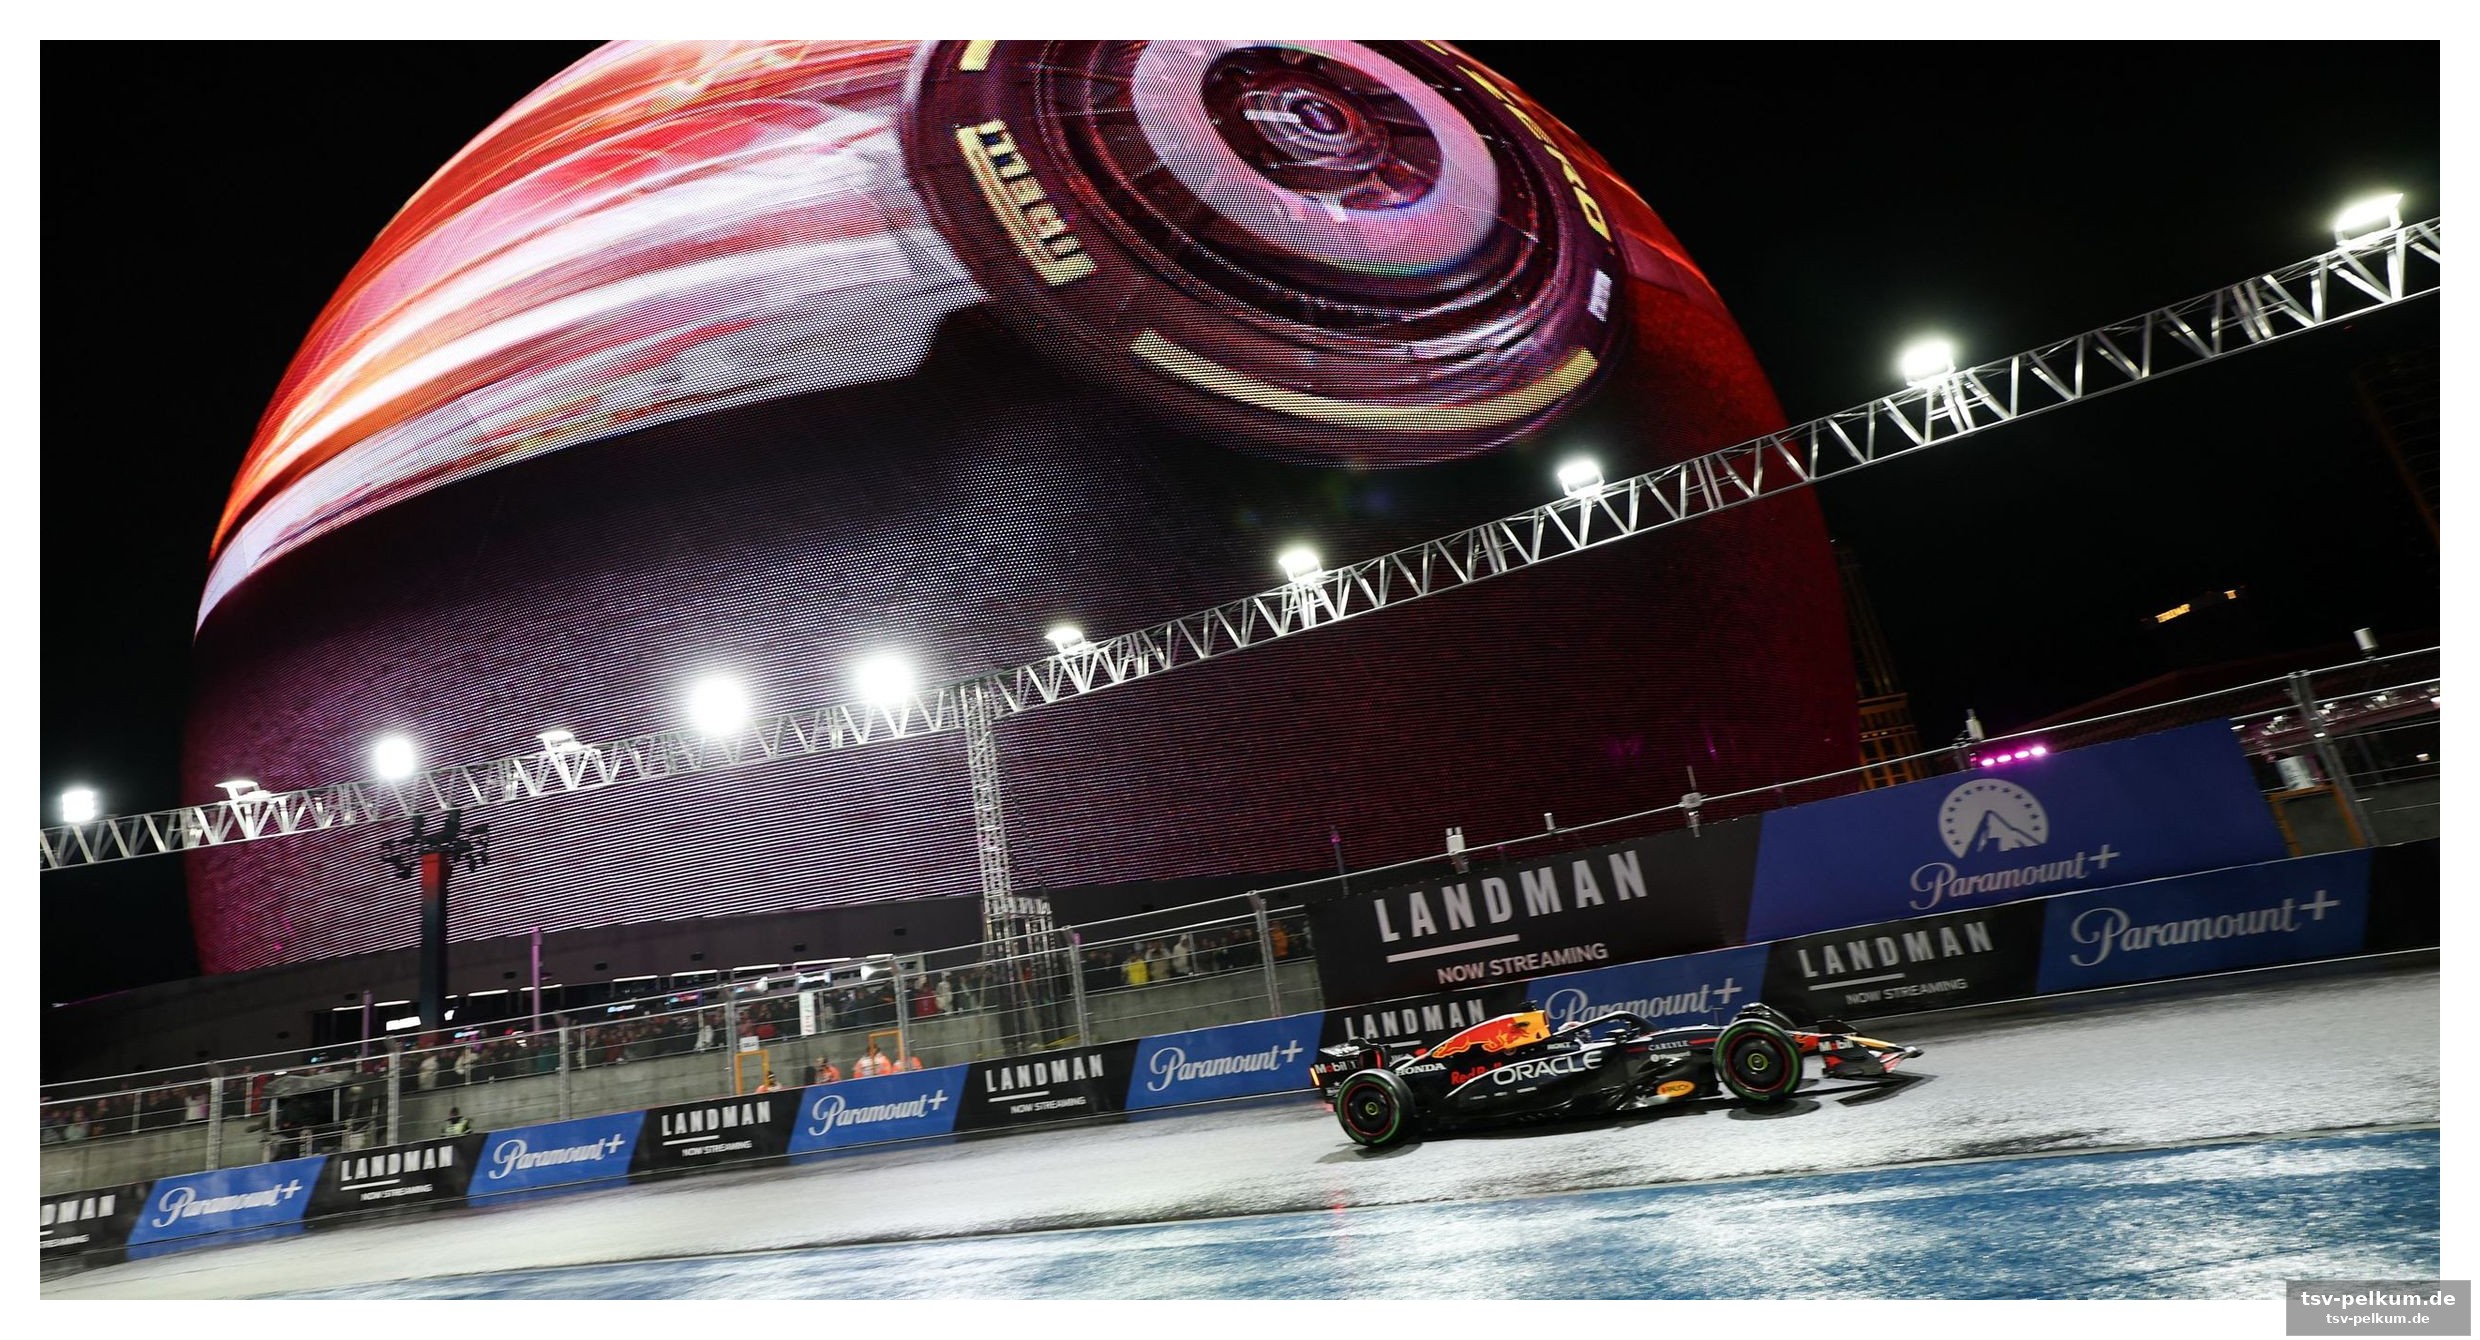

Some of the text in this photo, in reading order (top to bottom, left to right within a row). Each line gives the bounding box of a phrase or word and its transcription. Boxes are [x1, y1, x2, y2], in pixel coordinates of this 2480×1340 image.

[1374, 850, 1648, 943] LANDMAN
[1436, 942, 1609, 985] NOW STREAMING
[1799, 921, 1994, 978] LANDMAN
[1846, 978, 1968, 1005] NOW STREAMING
[1344, 998, 1485, 1040] LANDMAN
[985, 1054, 1104, 1092] LANDMAN
[1314, 1061, 1348, 1074] Mobil
[1395, 1063, 1447, 1077] HONDA
[1493, 1050, 1603, 1086] ORACLE
[661, 1101, 771, 1136] LANDMAN
[340, 1145, 454, 1182] LANDMAN
